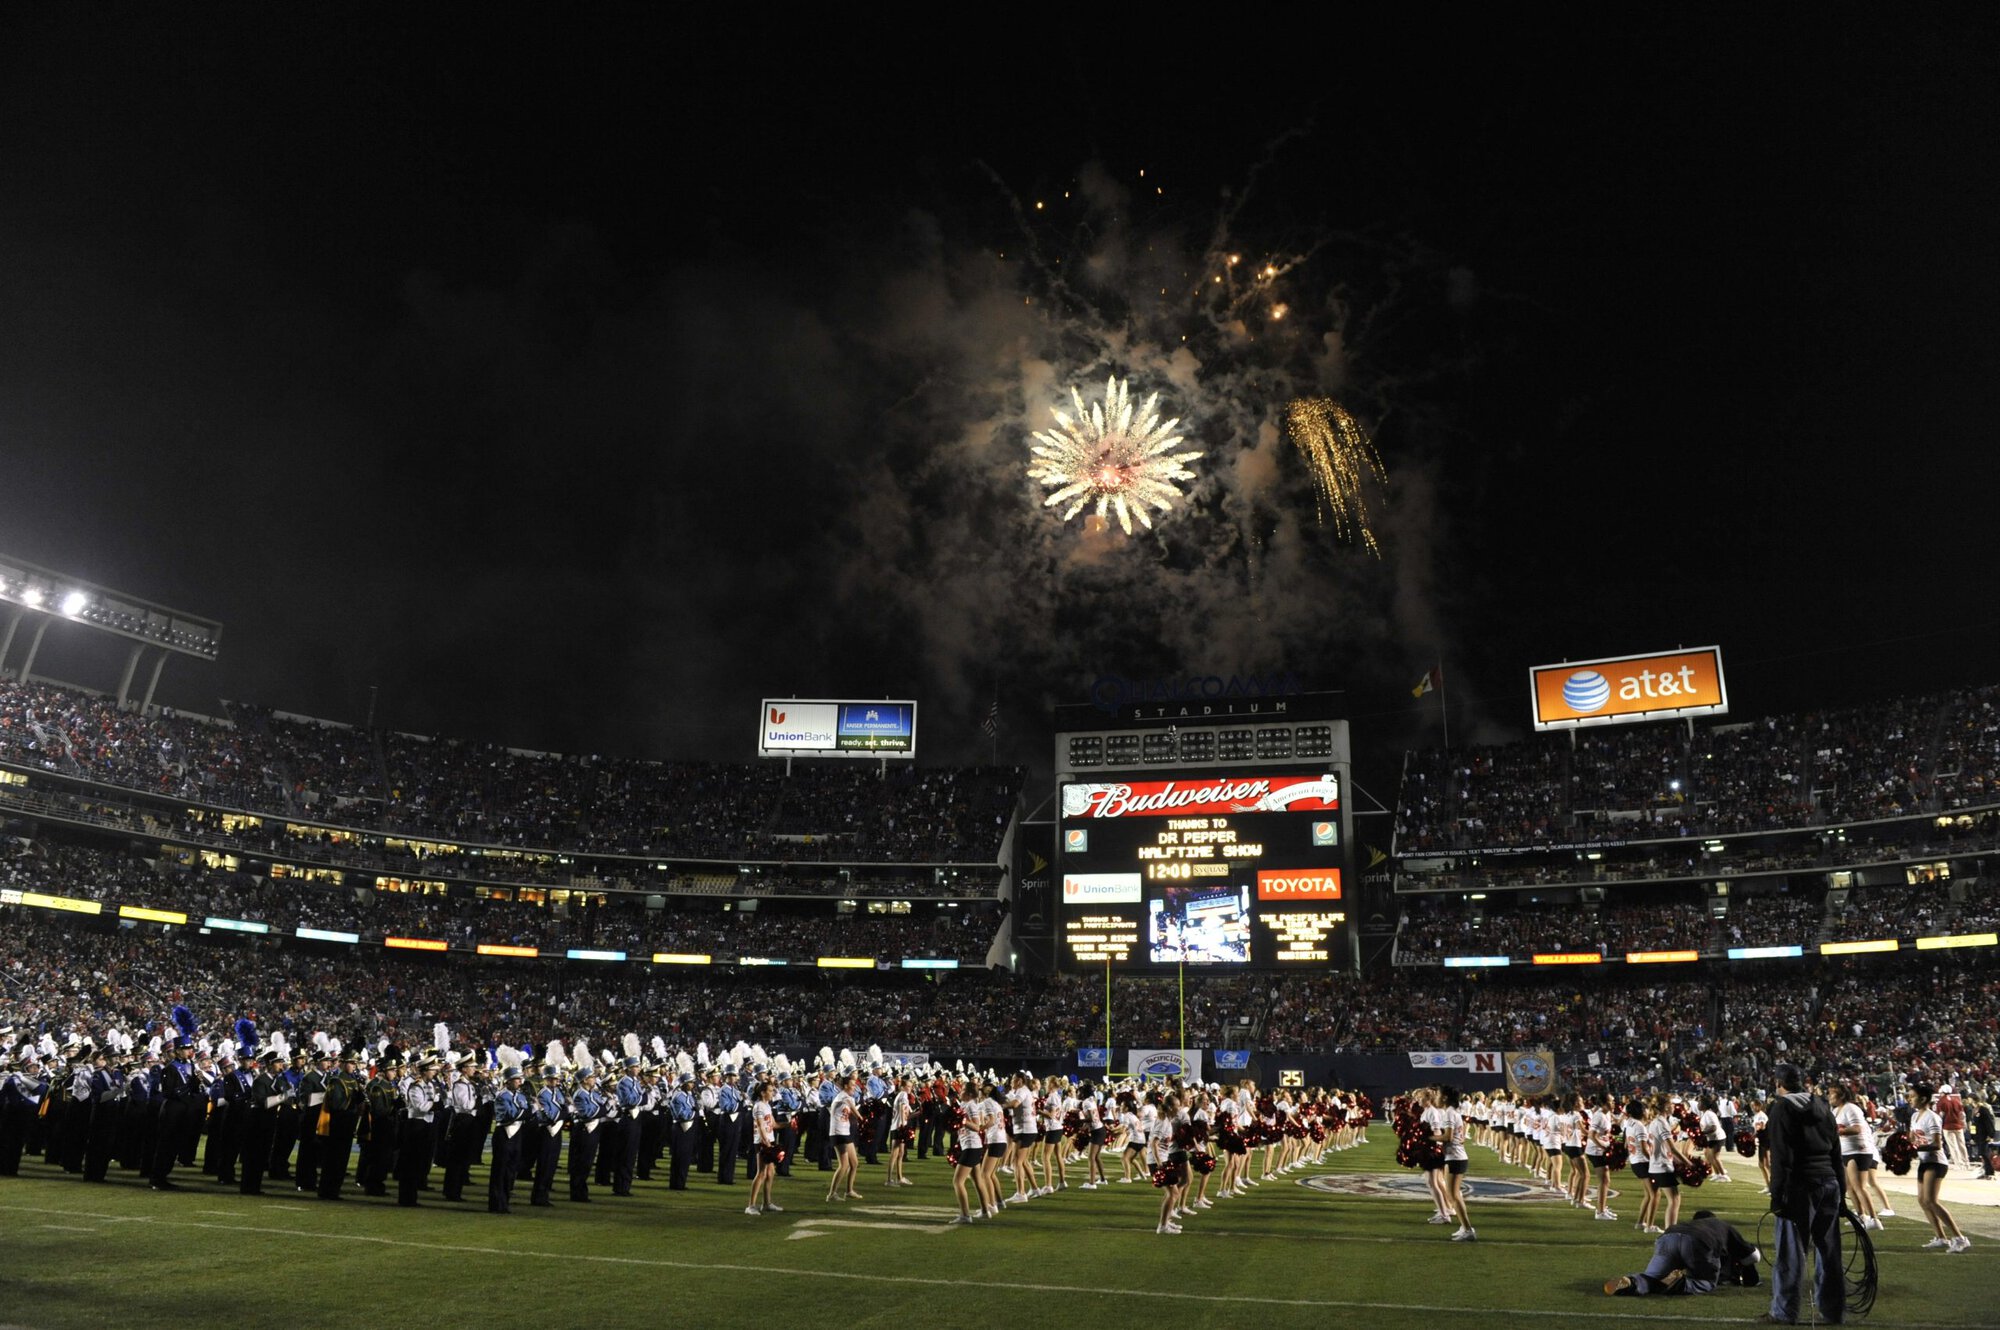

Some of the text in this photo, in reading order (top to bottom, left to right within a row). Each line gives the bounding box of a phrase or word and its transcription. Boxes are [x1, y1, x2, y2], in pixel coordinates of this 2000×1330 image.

[1619, 665, 1697, 700] at&t
[1092, 675, 1303, 719] QUALCOMM
[1134, 703, 1286, 718] STADIUM
[769, 731, 832, 742] UnionBank
[1088, 778, 1270, 818] Budweiser
[1168, 818, 1227, 830] THANKS TO
[1158, 831, 1237, 844] DR PEPPER
[1139, 843, 1262, 859] HALFTIME SHOW
[1083, 883, 1138, 894] UnionBank
[1262, 878, 1336, 893] TOYOTA
[1146, 1054, 1170, 1065] PACIFIC
[1475, 1054, 1495, 1071] N
[1283, 1071, 1301, 1086] 25
